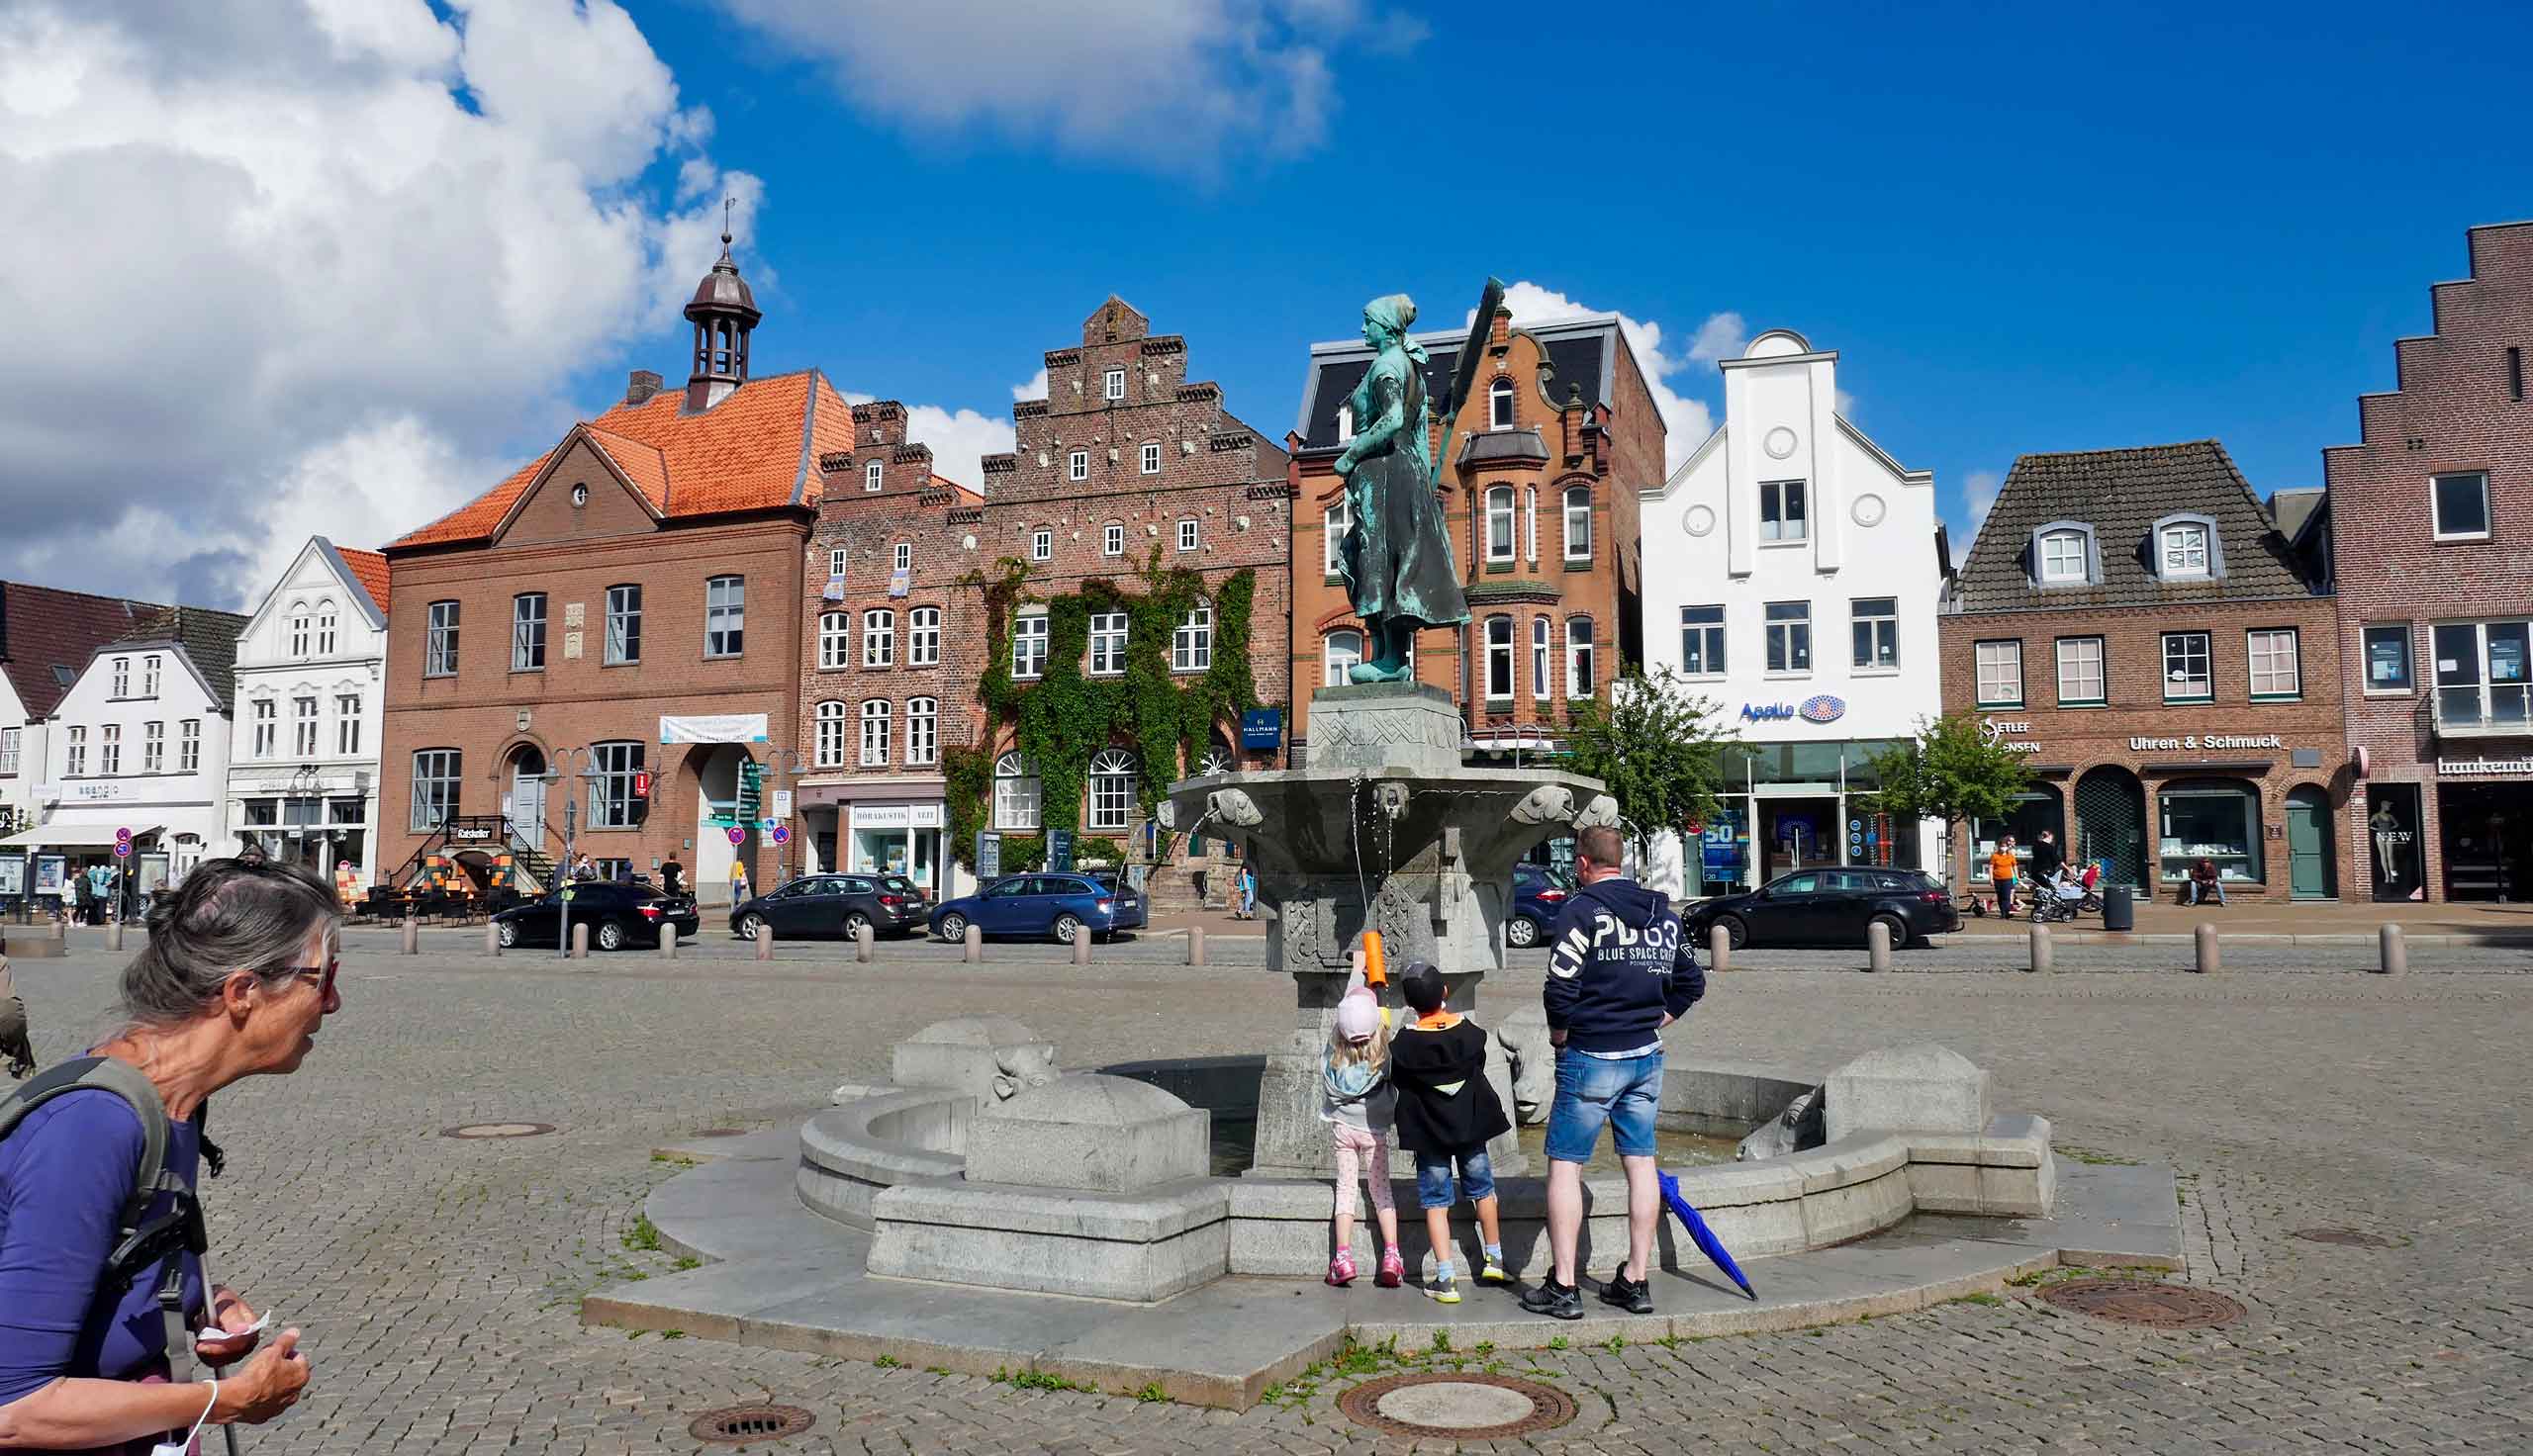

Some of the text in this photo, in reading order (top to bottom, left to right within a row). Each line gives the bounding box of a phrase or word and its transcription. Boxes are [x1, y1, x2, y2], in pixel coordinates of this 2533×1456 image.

[1741, 702, 1794, 721] Apollo
[2003, 743, 2040, 753] ENSEN
[2129, 735, 2281, 750] Uhren & Schmuck
[1705, 824, 1734, 843] 50
[2376, 832, 2412, 841] NEW
[1598, 948, 1625, 960] BLUE
[1630, 948, 1657, 960] SPACE
